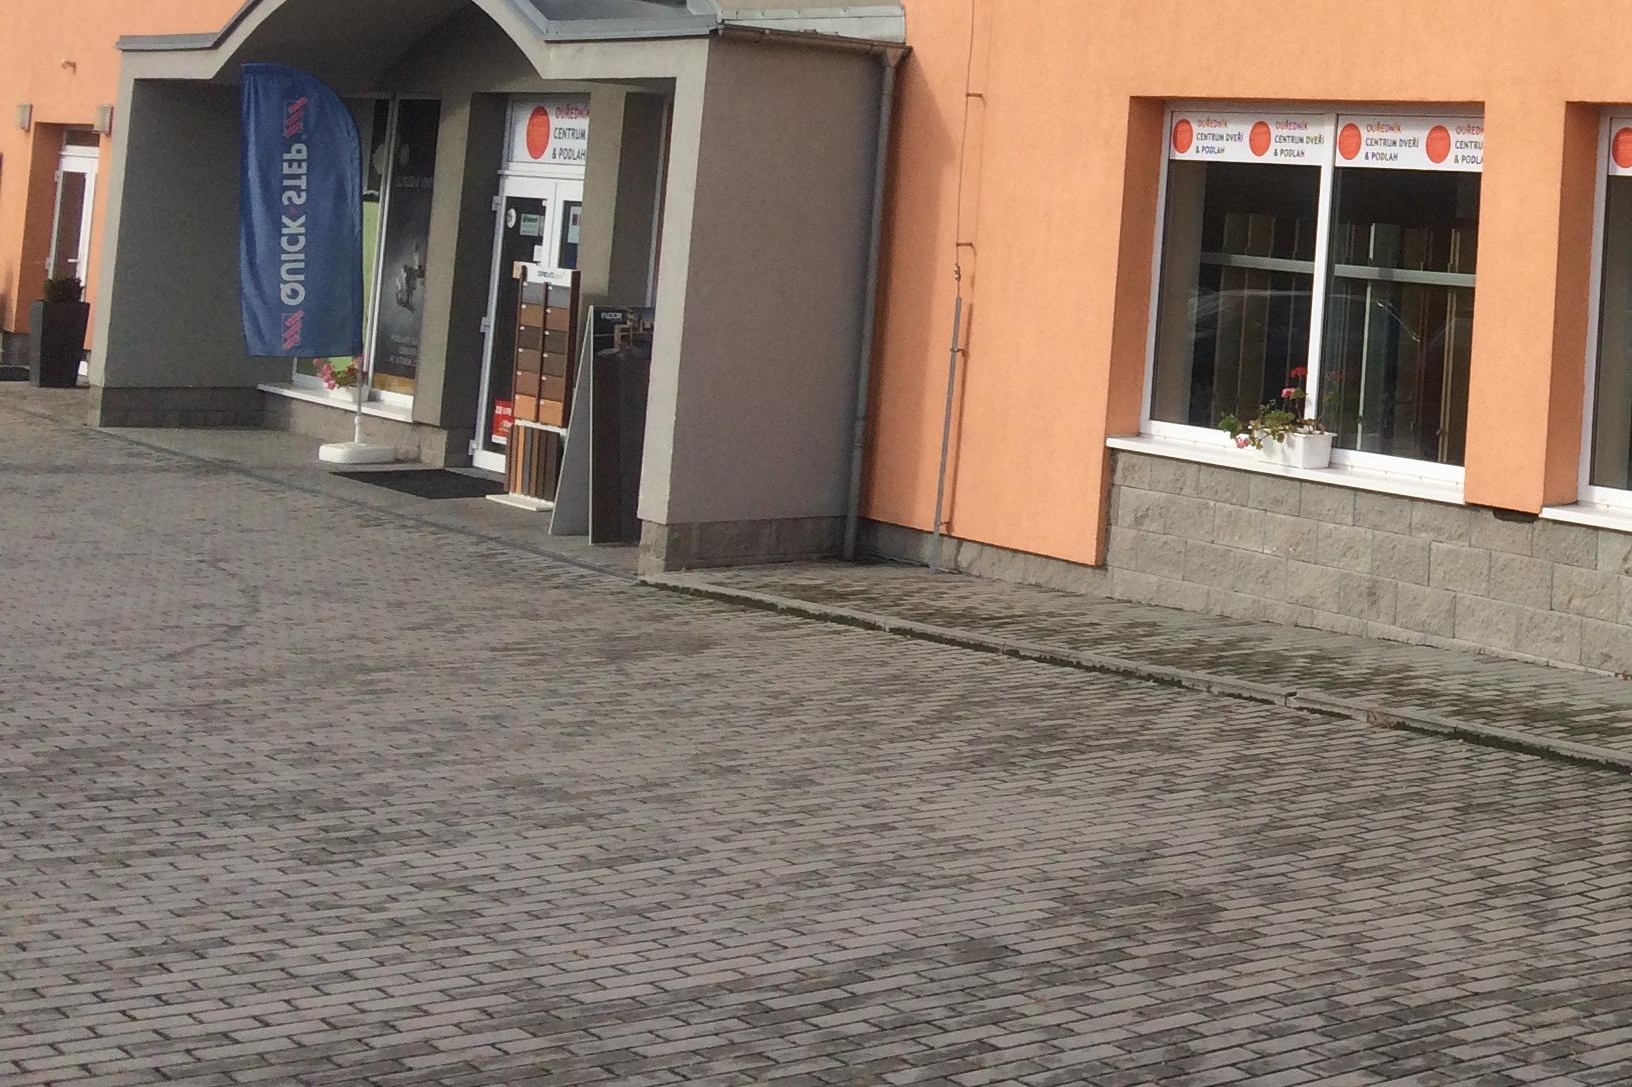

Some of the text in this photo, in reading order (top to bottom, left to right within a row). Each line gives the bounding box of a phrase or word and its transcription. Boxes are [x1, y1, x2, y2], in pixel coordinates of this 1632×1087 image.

[554, 127, 585, 140] CENTRUM
[1196, 132, 1244, 143] CENTRUM DVEŘÍ
[1274, 134, 1324, 145] CENTRUM DVEŘÍ
[1365, 137, 1419, 149] CENTRUM DVEŘÍ
[552, 148, 585, 160] & PODLAH
[1195, 145, 1225, 155] & PODLAH
[1274, 148, 1305, 158] & PODLAH
[1364, 152, 1398, 162] & PODLAH
[1454, 155, 1460, 164] &
